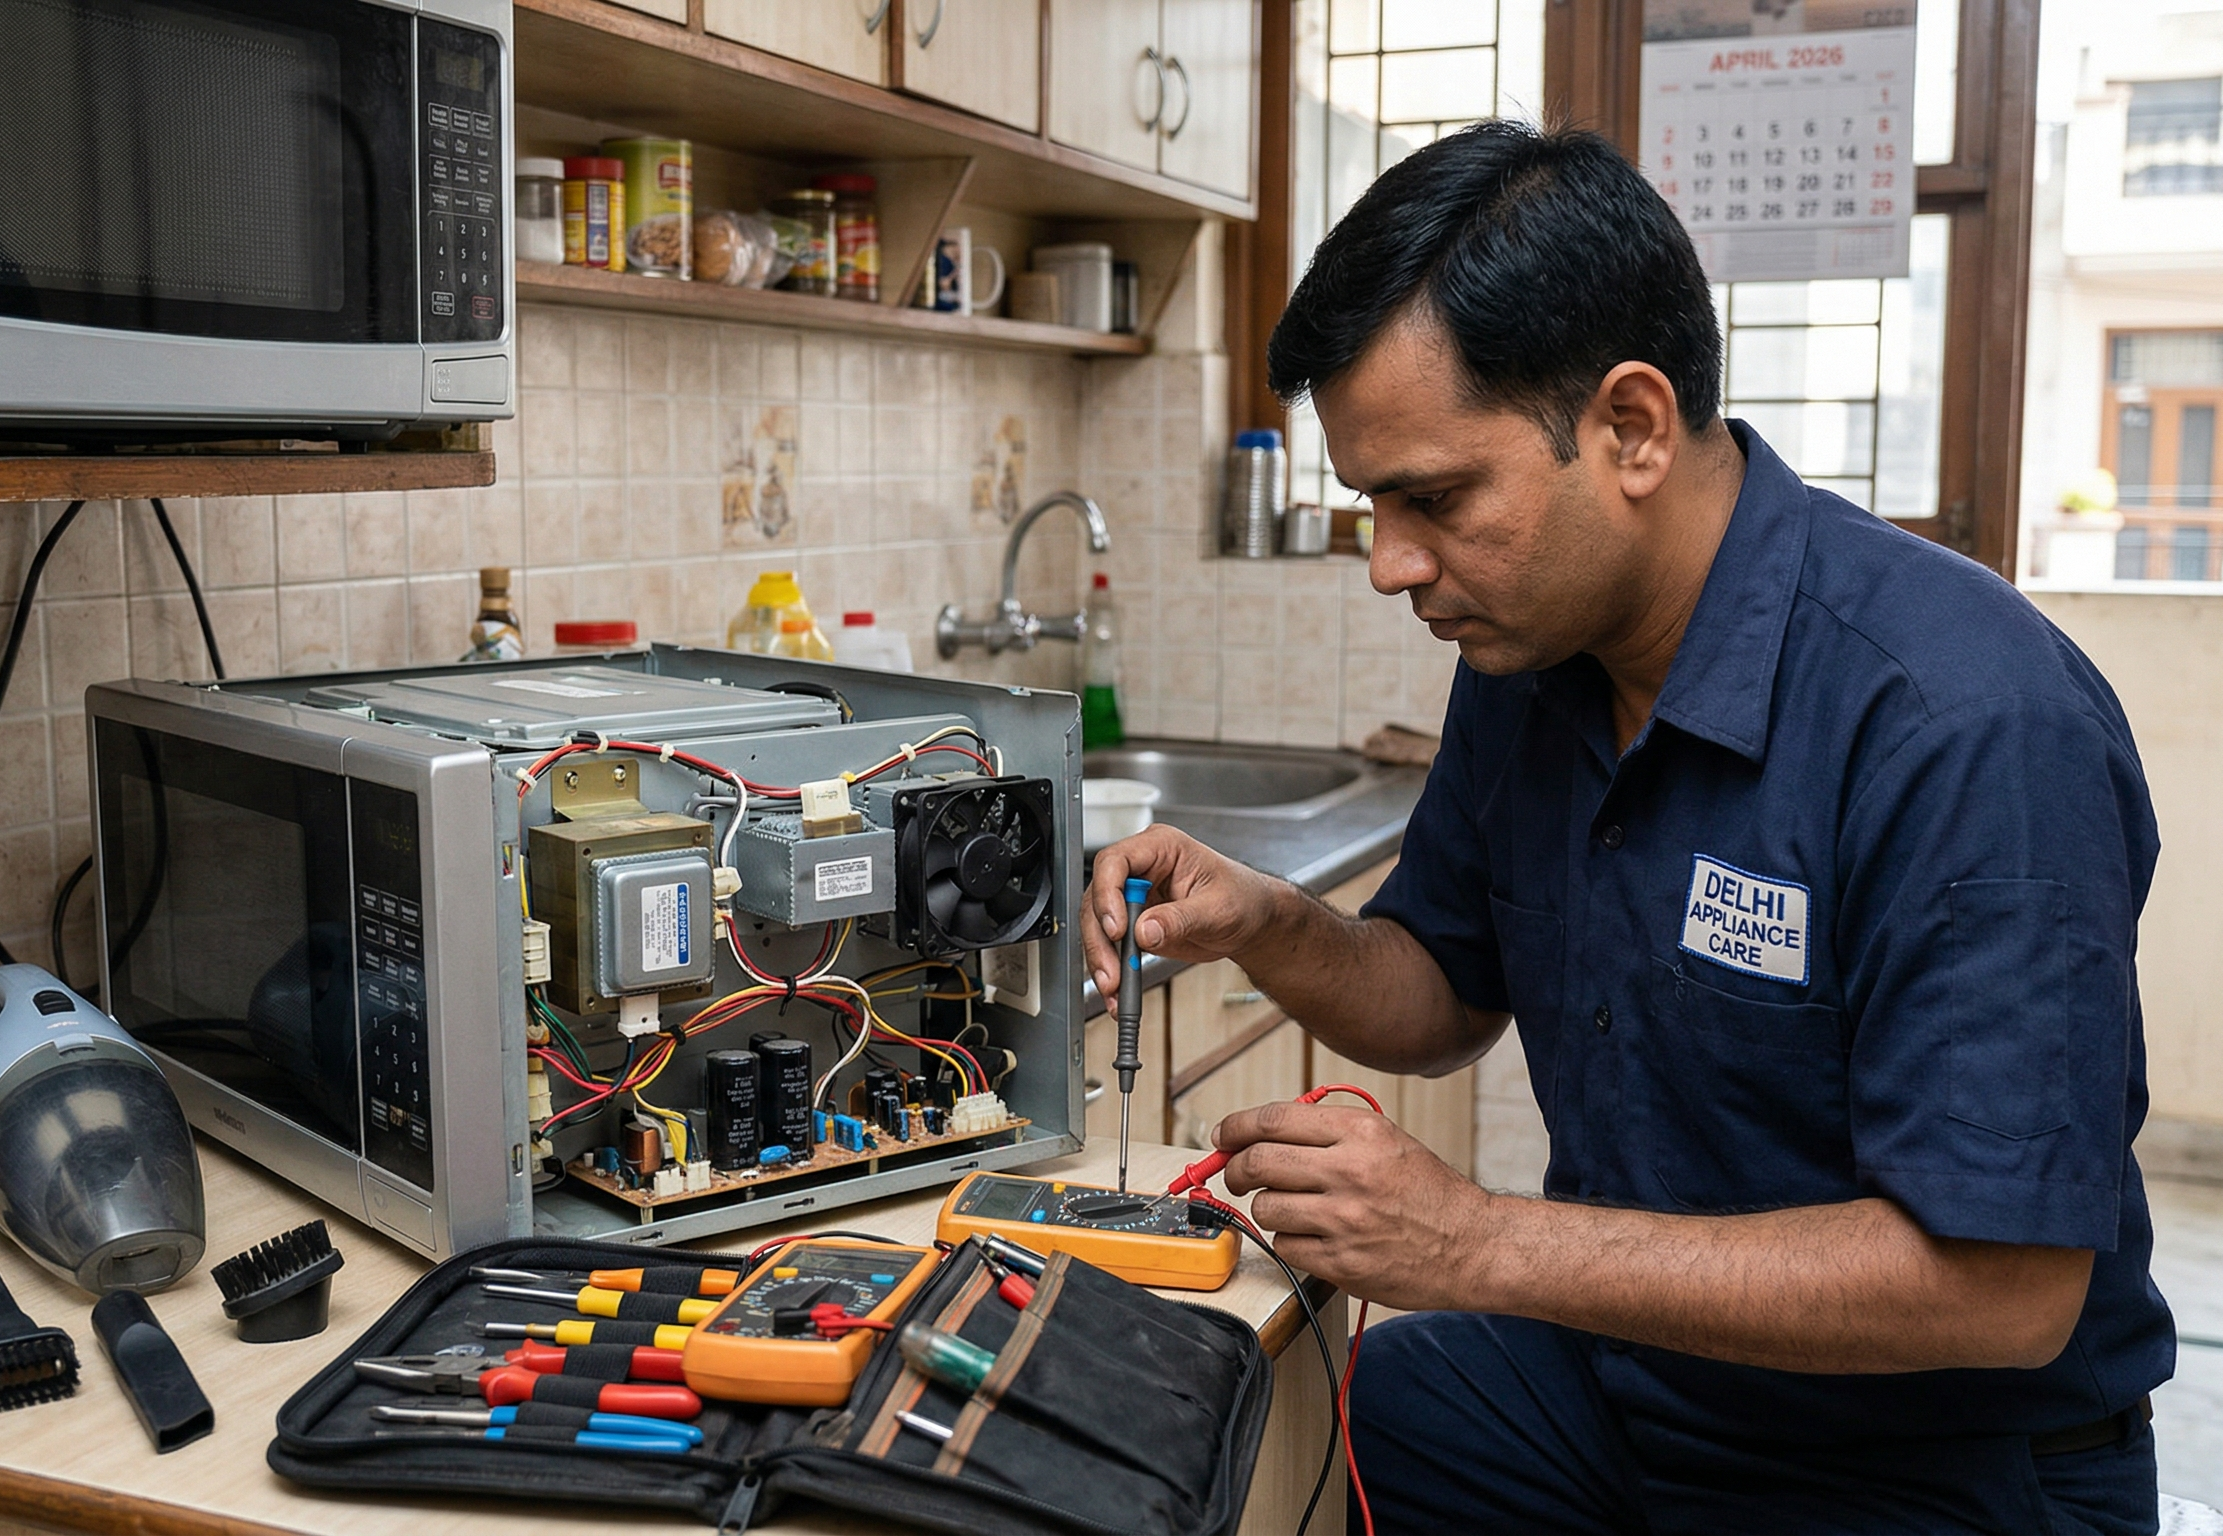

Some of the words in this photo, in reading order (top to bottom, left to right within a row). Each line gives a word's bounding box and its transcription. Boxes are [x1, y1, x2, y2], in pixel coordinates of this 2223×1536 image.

[1709, 48, 1778, 72] APRIL
[1787, 45, 1844, 68] 2026
[1880, 86, 1890, 105] 1
[1697, 124, 1709, 143] 3
[1732, 122, 1746, 141] 4
[1768, 121, 1780, 140] 5
[1803, 118, 1817, 138] 6
[1842, 117, 1853, 137] 7
[1694, 150, 1715, 169] 10
[1729, 149, 1747, 167] 11
[1764, 147, 1785, 167] 12
[1800, 146, 1820, 165] 13
[1837, 144, 1858, 163] 14
[1873, 143, 1896, 162] 15
[1693, 177, 1713, 194] 17
[1728, 176, 1748, 195] 18
[1764, 174, 1784, 193] 19
[1797, 172, 1820, 192] 20
[1832, 171, 1855, 191] 21
[1870, 170, 1894, 189] 22
[1691, 204, 1713, 221] 24
[1725, 203, 1748, 221] 25
[1760, 202, 1784, 221] 26
[1795, 199, 1820, 219] 27
[1831, 198, 1856, 218] 28
[1869, 197, 1894, 216] 29
[461, 223, 466, 234] 2
[481, 226, 487, 237] 3
[438, 245, 444, 256] 4
[461, 248, 467, 259] 5
[482, 250, 487, 262] 6
[1704, 870, 1785, 922] DELHI
[1689, 901, 1801, 950] APPLIANCE
[1708, 933, 1762, 968] CARE
[391, 1024, 397, 1037] 2
[393, 1053, 398, 1065] 5
